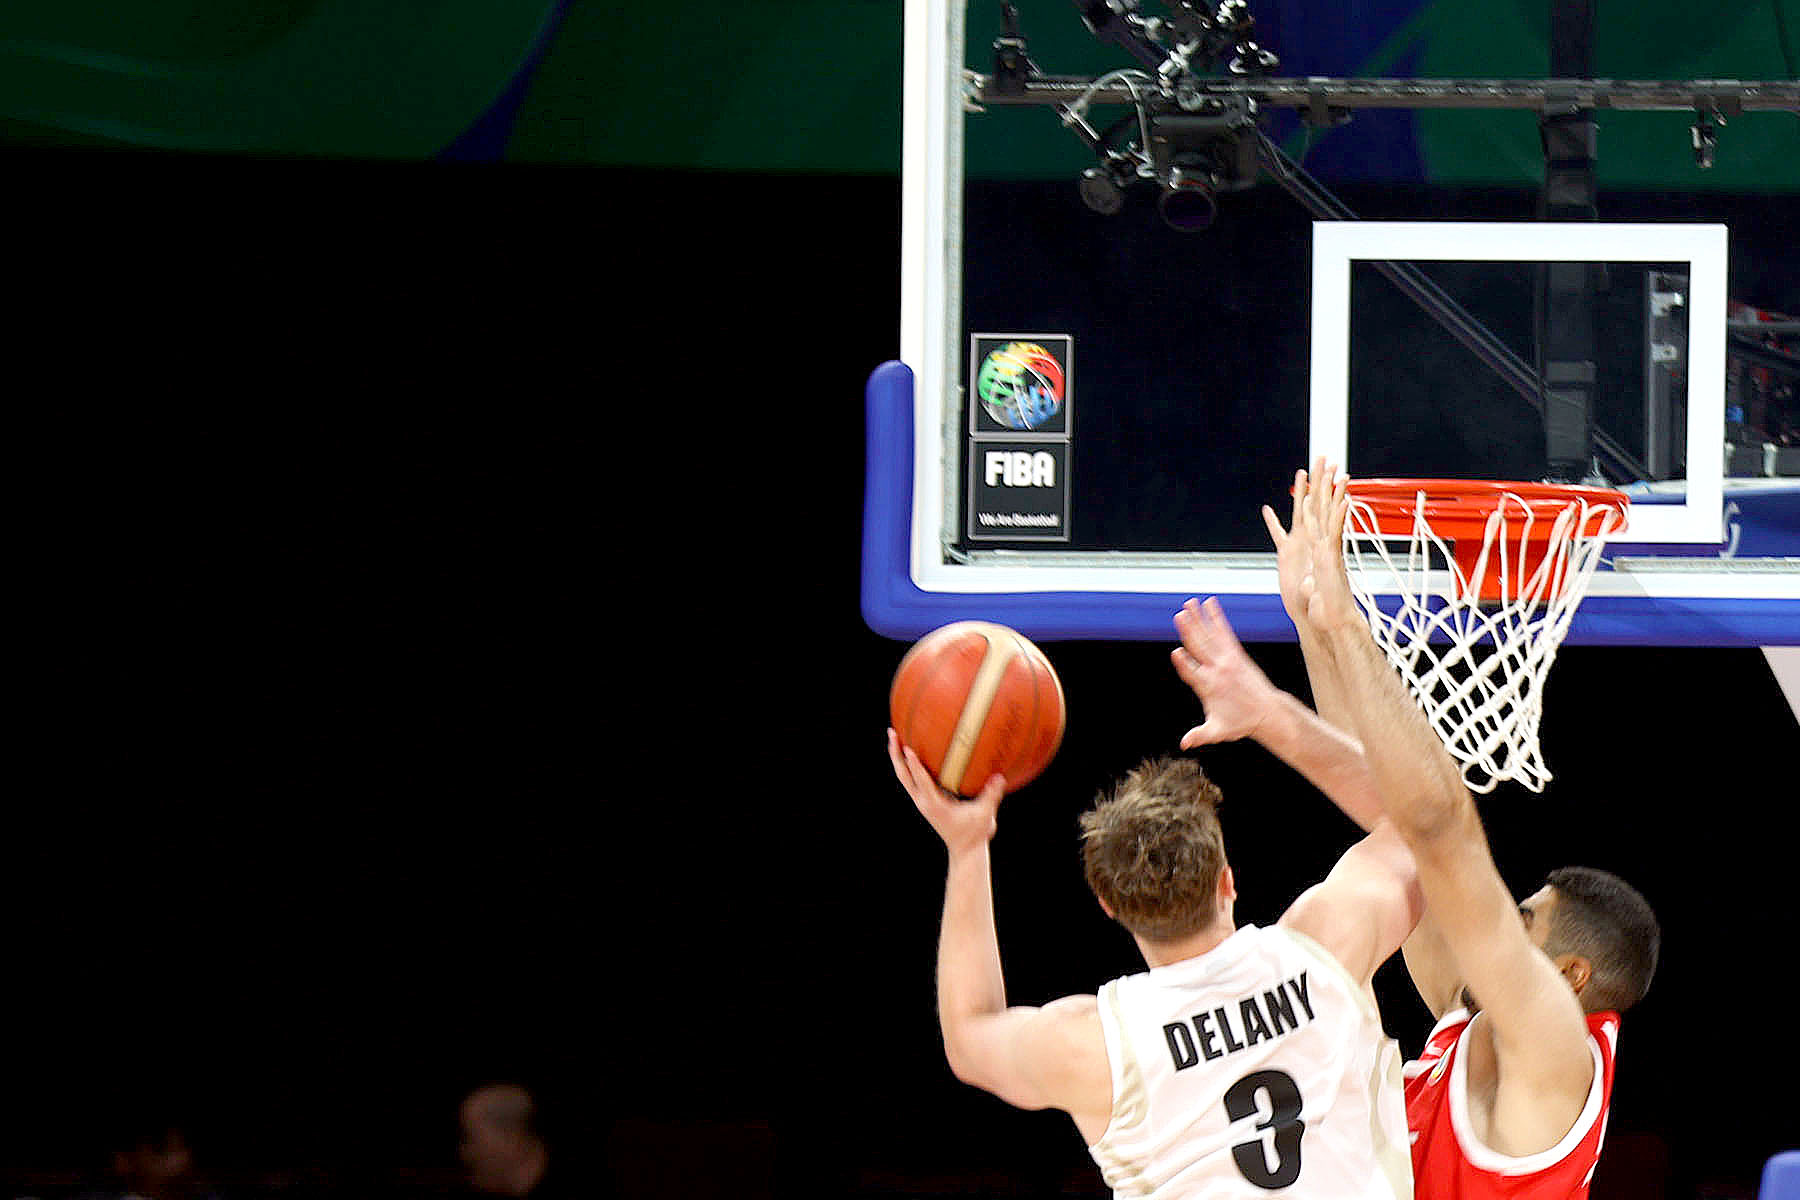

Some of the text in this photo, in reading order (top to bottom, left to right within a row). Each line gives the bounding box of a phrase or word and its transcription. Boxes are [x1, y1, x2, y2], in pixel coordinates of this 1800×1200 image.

[985, 451, 1056, 488] FIBA
[1163, 971, 1317, 1071] DELANY
[1223, 1070, 1306, 1190] 3
